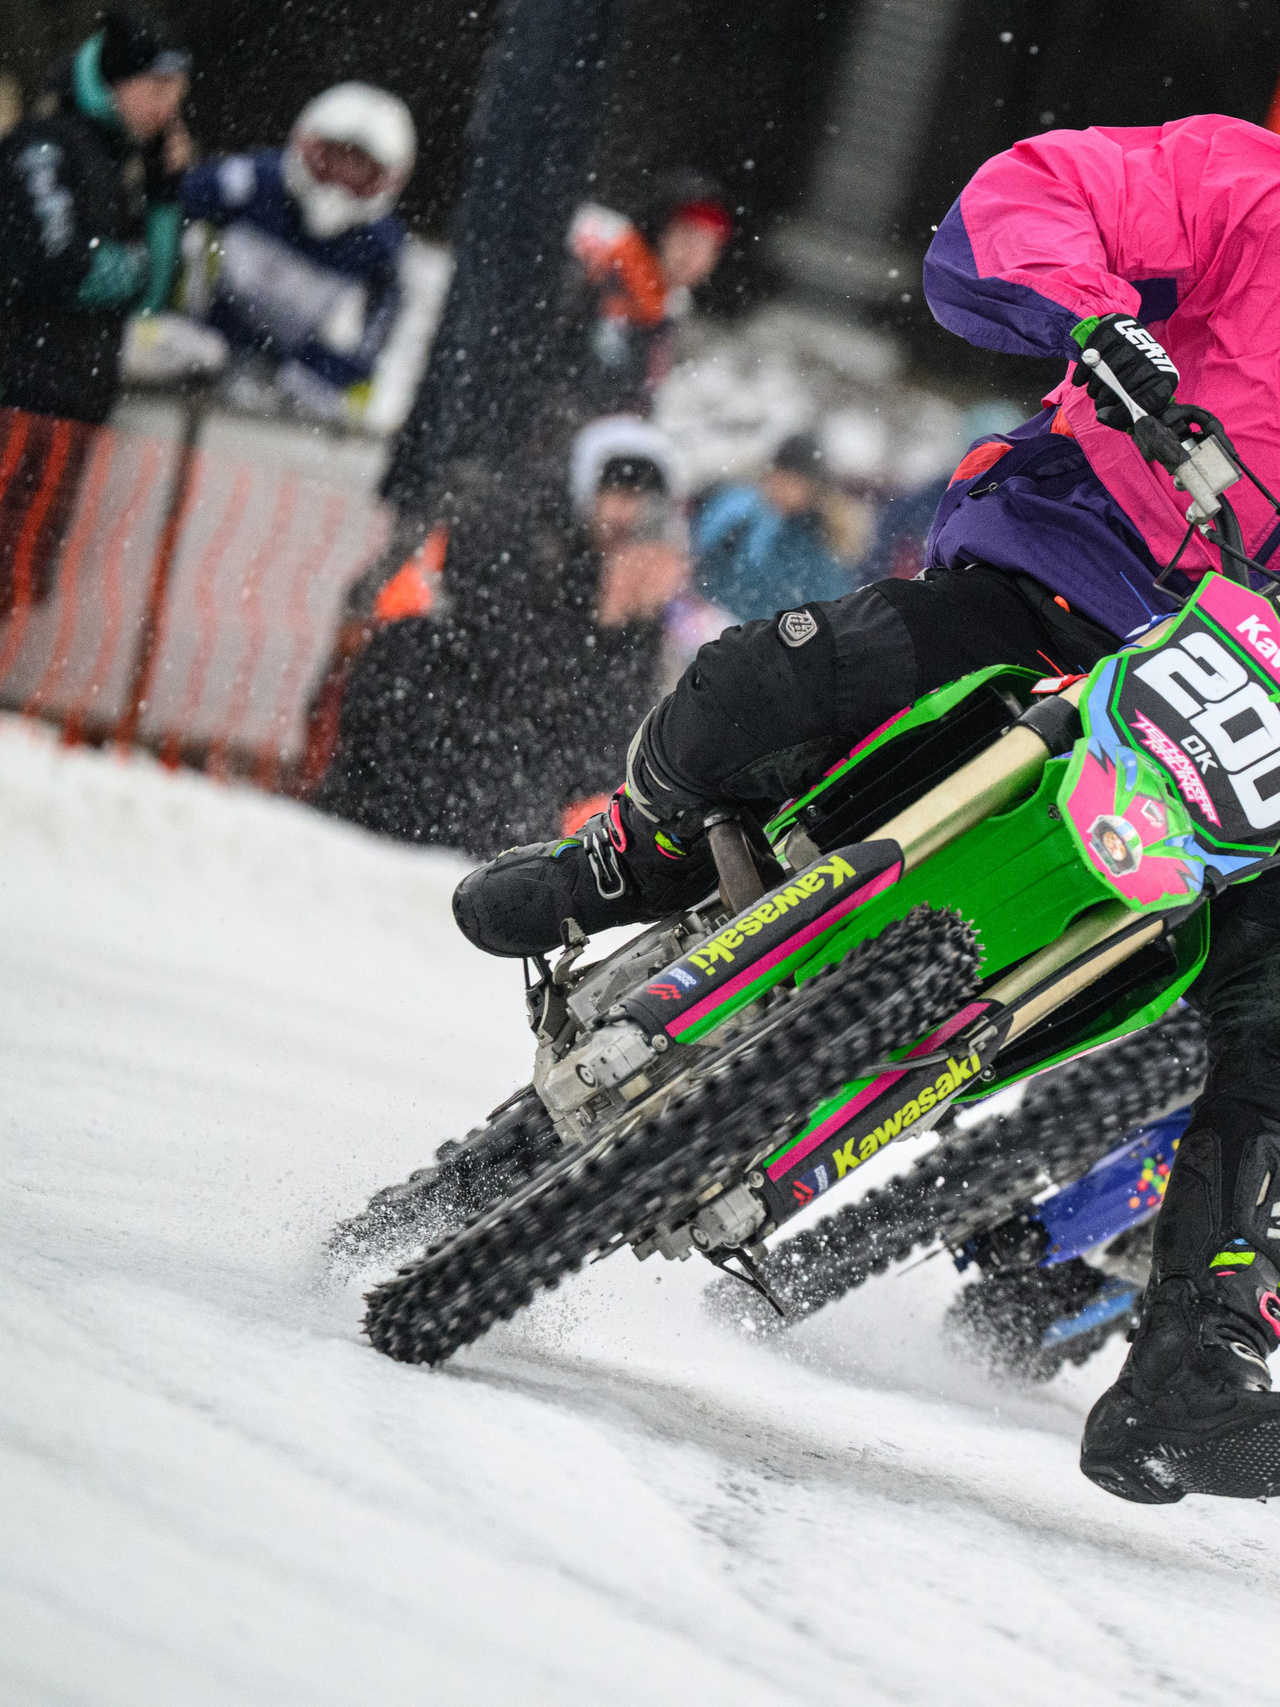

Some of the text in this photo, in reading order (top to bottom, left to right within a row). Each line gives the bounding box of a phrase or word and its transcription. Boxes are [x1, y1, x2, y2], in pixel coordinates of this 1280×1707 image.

[1114, 319, 1180, 382] LEATT
[1143, 739, 1199, 801] RACING
[1180, 734, 1219, 775] OK
[687, 855, 857, 976] Kawasaki
[832, 1053, 982, 1179] Kawasaki
